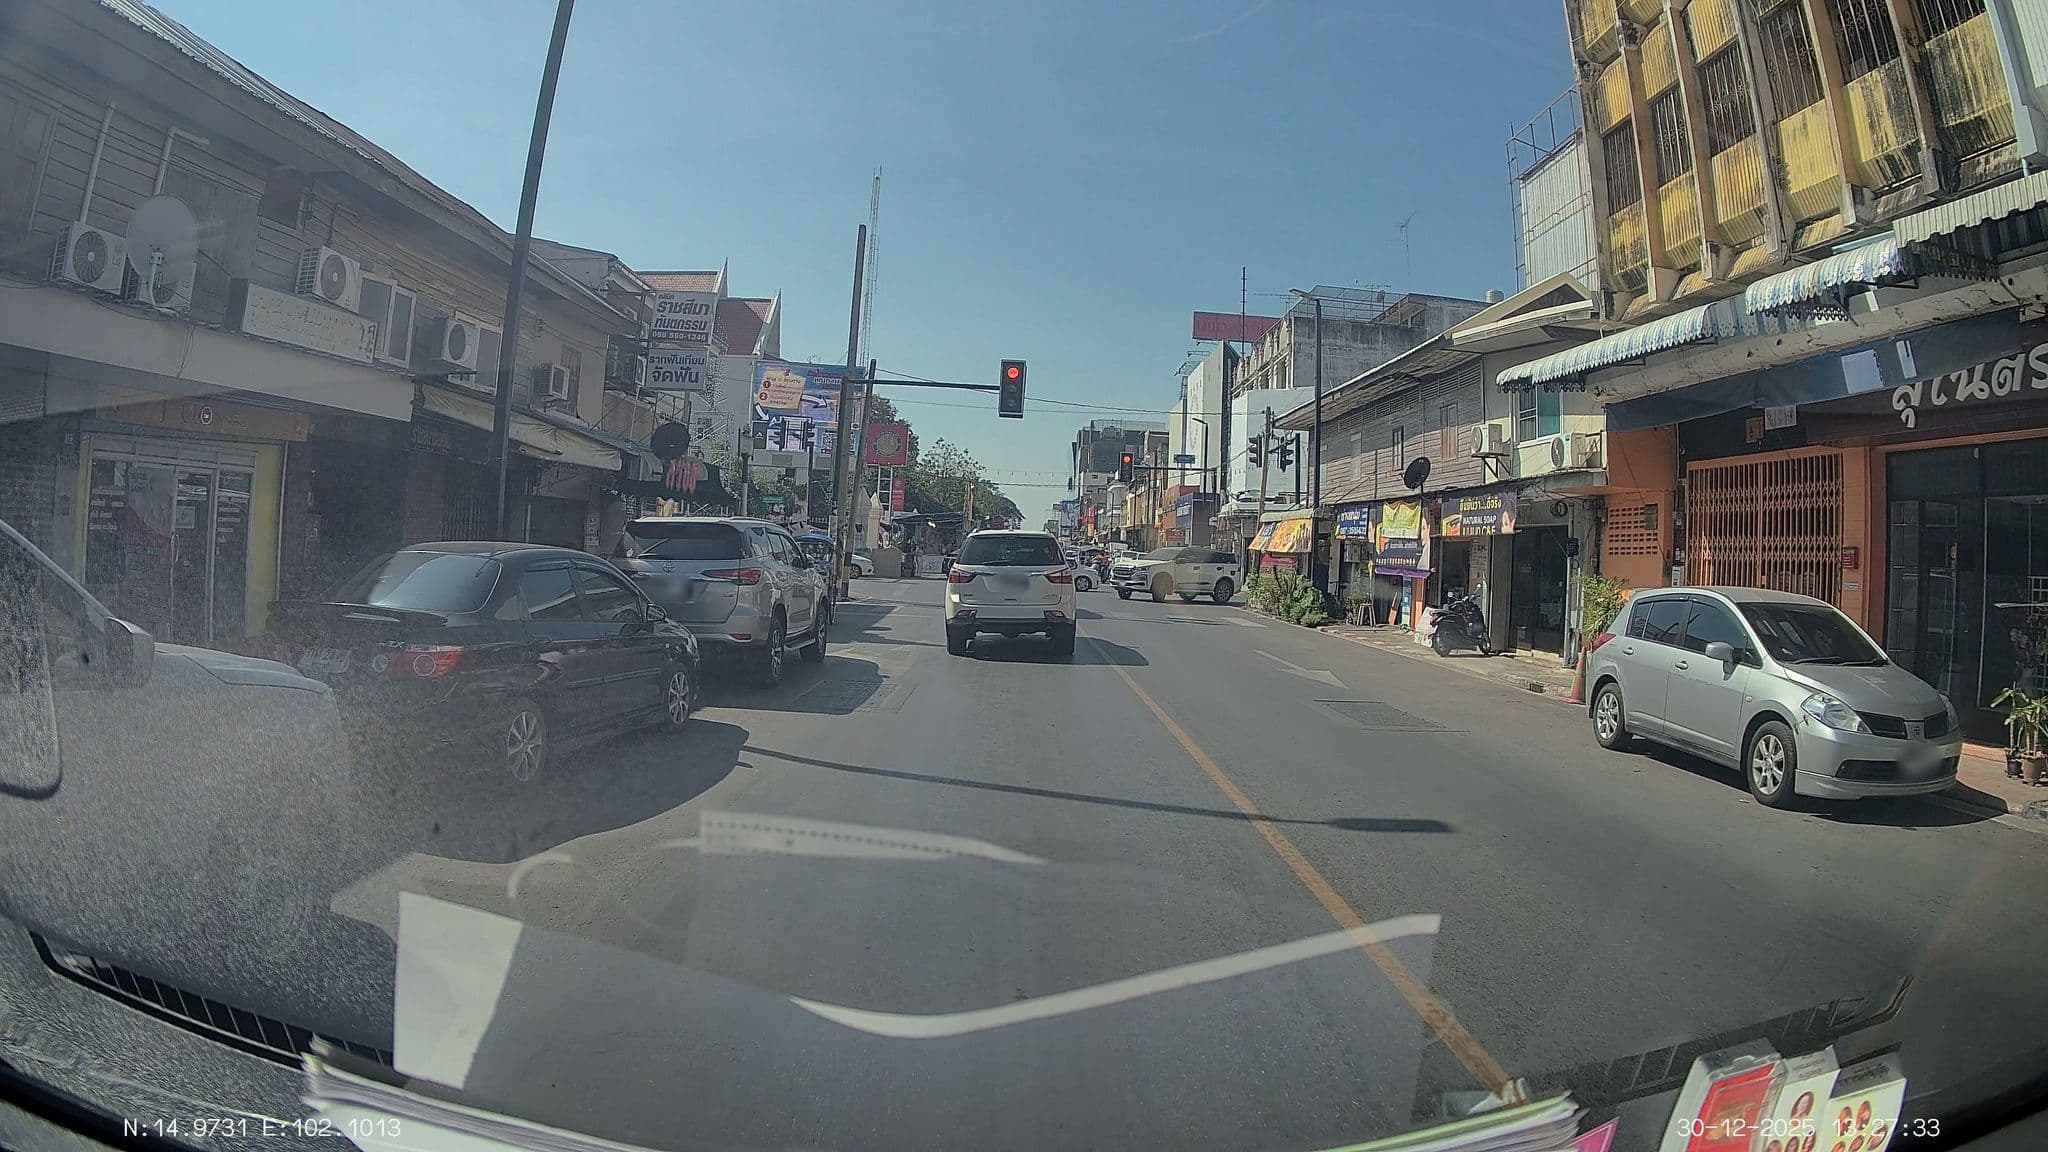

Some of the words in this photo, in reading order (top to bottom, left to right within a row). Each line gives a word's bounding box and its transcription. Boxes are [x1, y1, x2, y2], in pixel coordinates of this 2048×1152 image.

[656, 299, 710, 316] ราชสีมา
[654, 314, 708, 331] ทันตกรรม
[649, 354, 705, 365] รากฟันเทียม
[652, 366, 700, 384] จัดฟัน
[1462, 515, 1483, 525] NATURAL
[1484, 514, 1497, 524] SOAP
